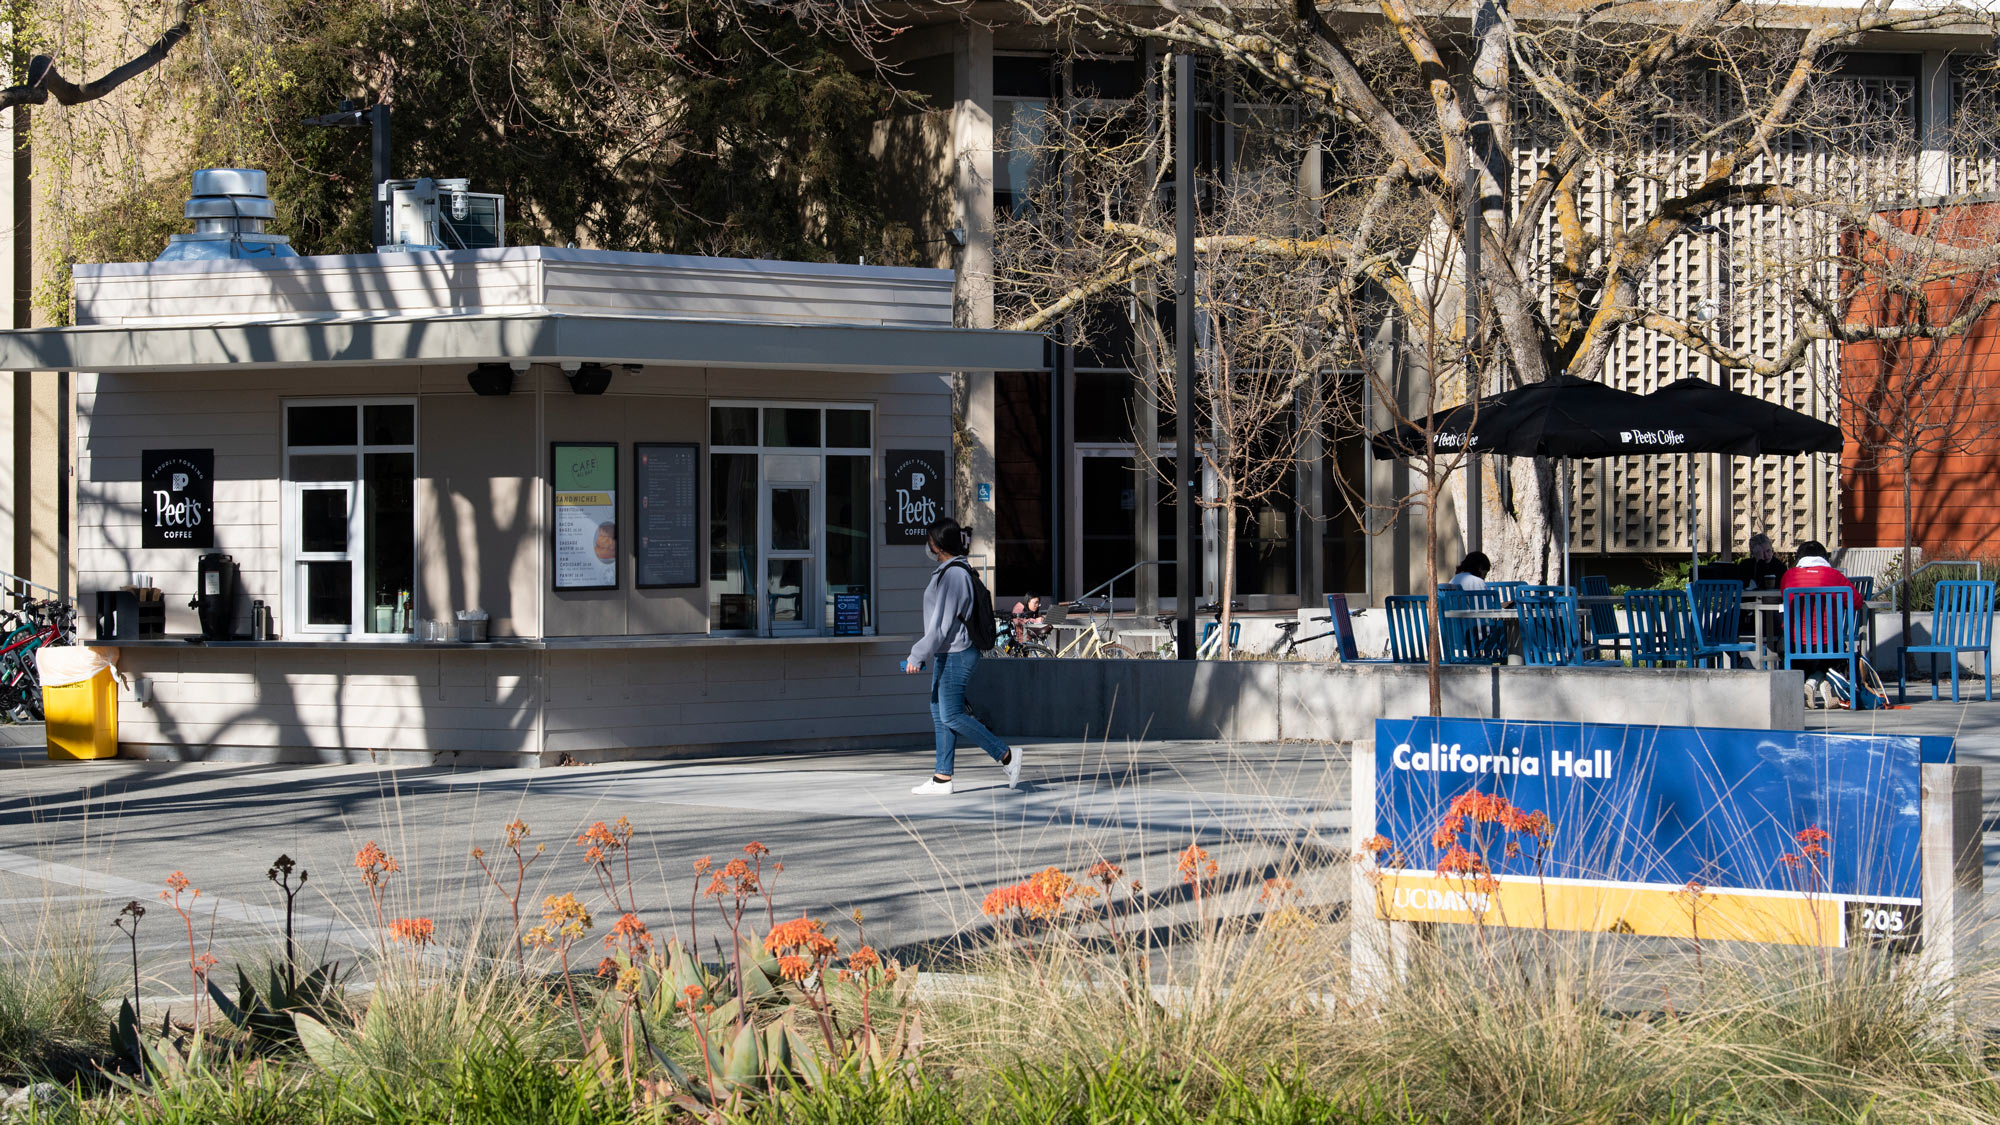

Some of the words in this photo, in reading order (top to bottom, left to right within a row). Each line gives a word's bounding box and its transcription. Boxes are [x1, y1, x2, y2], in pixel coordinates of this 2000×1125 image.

[1631, 429, 1657, 444] Peet's
[1657, 429, 1685, 446] Coffee
[151, 459, 176, 479] PROUDLY
[178, 459, 204, 480] POURING
[894, 459, 915, 479] PROUDLY
[916, 459, 938, 480] POURING
[153, 490, 202, 528] Peet's
[556, 495, 597, 503] SANDWICHES
[896, 489, 936, 526] Peet's
[164, 531, 193, 539] COFFEE
[1393, 743, 1539, 776] California
[1551, 749, 1612, 779] Hall
[1862, 908, 1903, 932] 205
